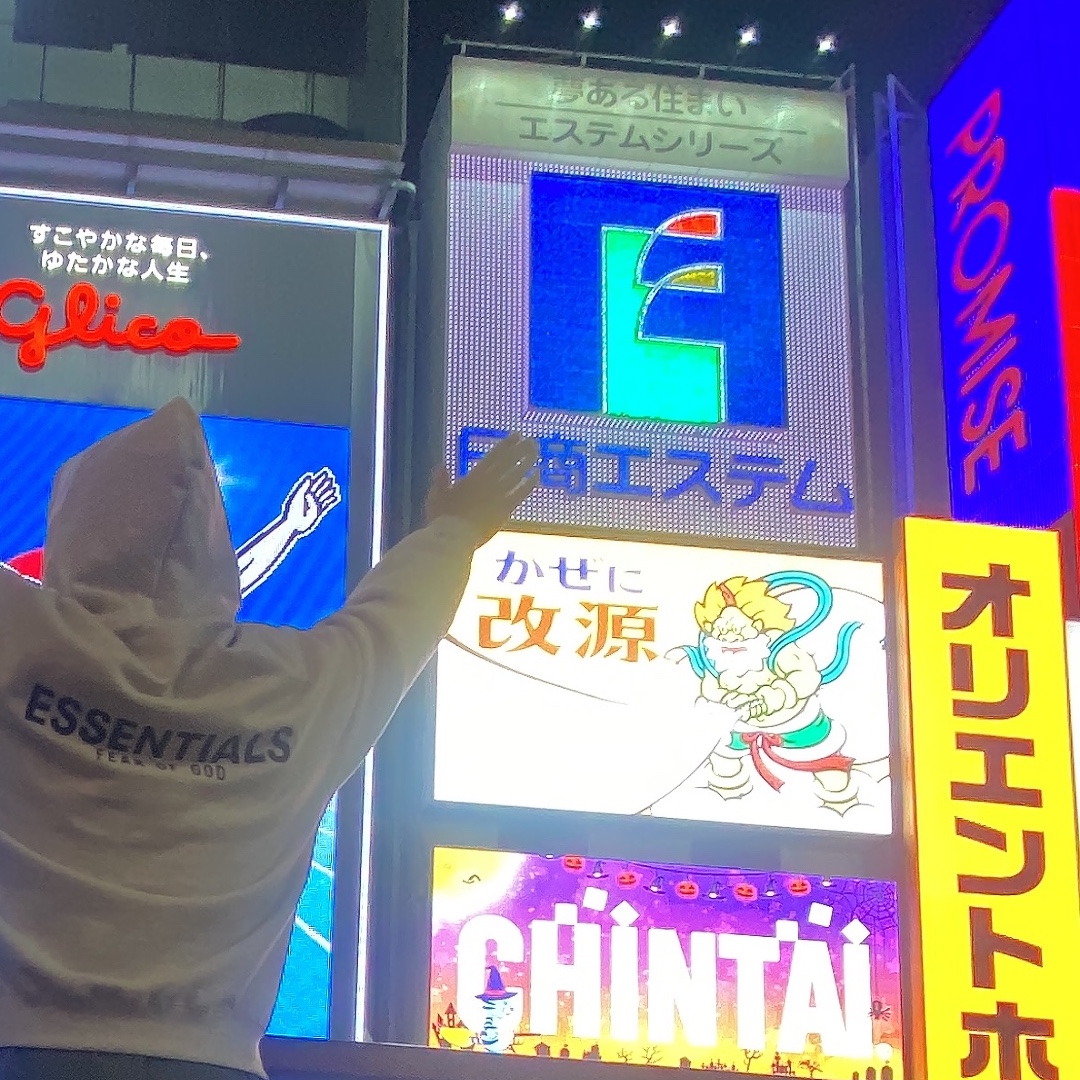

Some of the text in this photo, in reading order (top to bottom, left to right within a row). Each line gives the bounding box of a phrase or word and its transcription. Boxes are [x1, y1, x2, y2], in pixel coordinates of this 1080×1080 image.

[519, 115, 784, 166] エステムシリーズ
[29, 223, 210, 260] すこやかな毎日、
[41, 250, 191, 284] ゆたかな人生
[945, 87, 1029, 496] PROMISE
[496, 549, 645, 595] かぜに
[476, 594, 661, 664] 改源
[24, 682, 294, 765] ESSENTIALS
